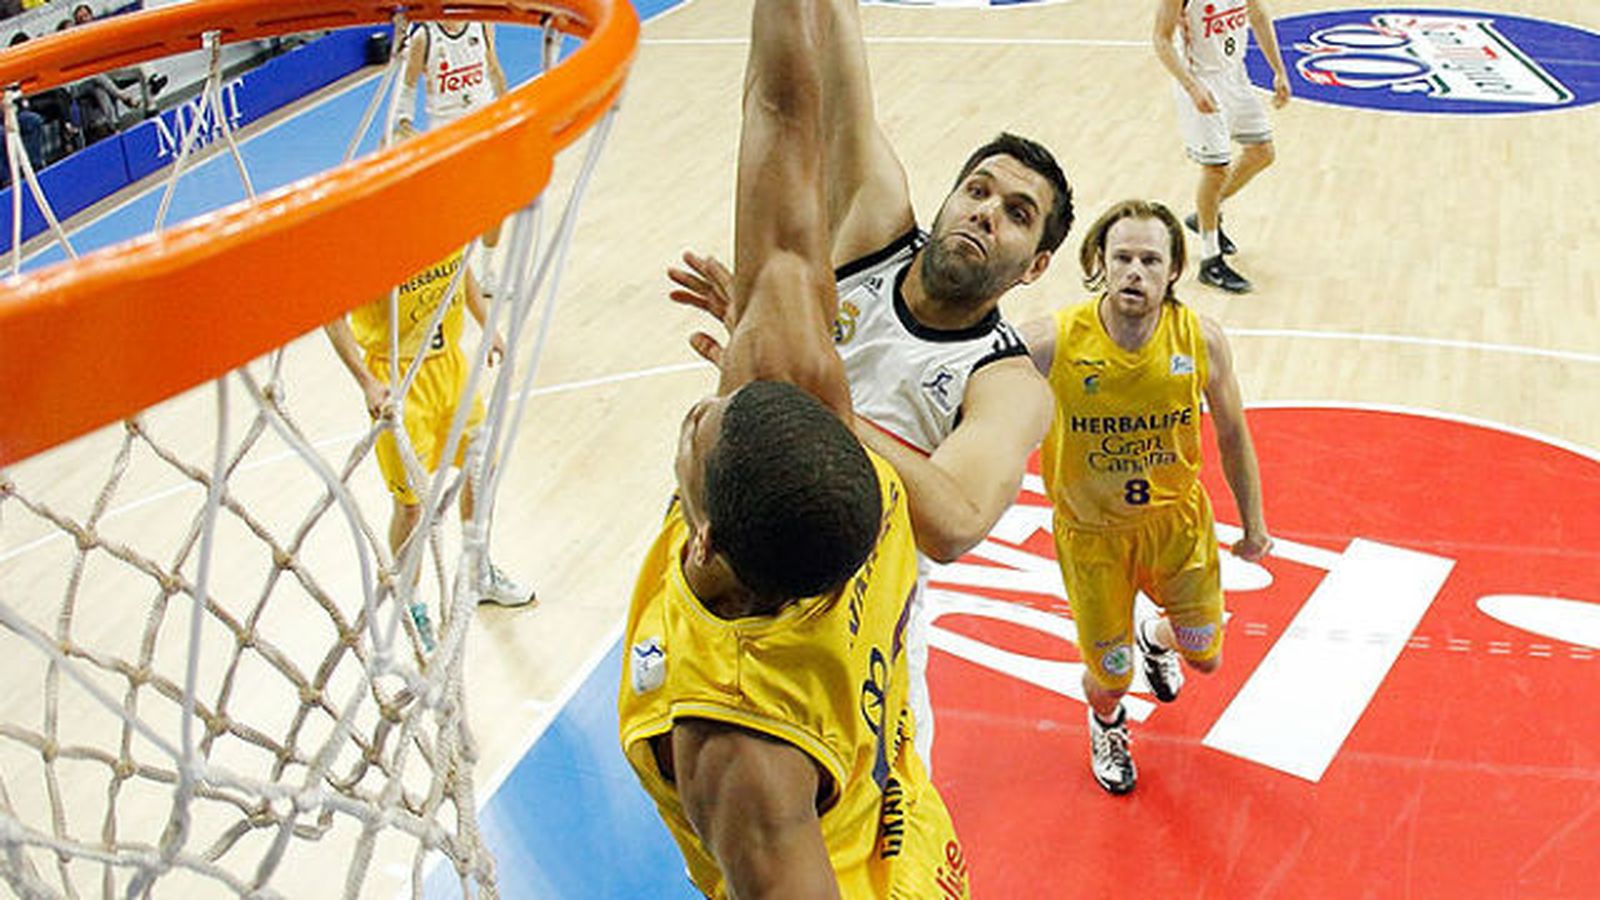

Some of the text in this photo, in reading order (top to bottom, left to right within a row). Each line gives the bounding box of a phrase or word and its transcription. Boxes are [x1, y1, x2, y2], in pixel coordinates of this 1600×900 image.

[1224, 36, 1236, 56] 8
[154, 78, 244, 157] MMT
[1071, 407, 1193, 434] HERBALIFE
[1101, 434, 1164, 457] Gran
[1124, 479, 1151, 505] 8
